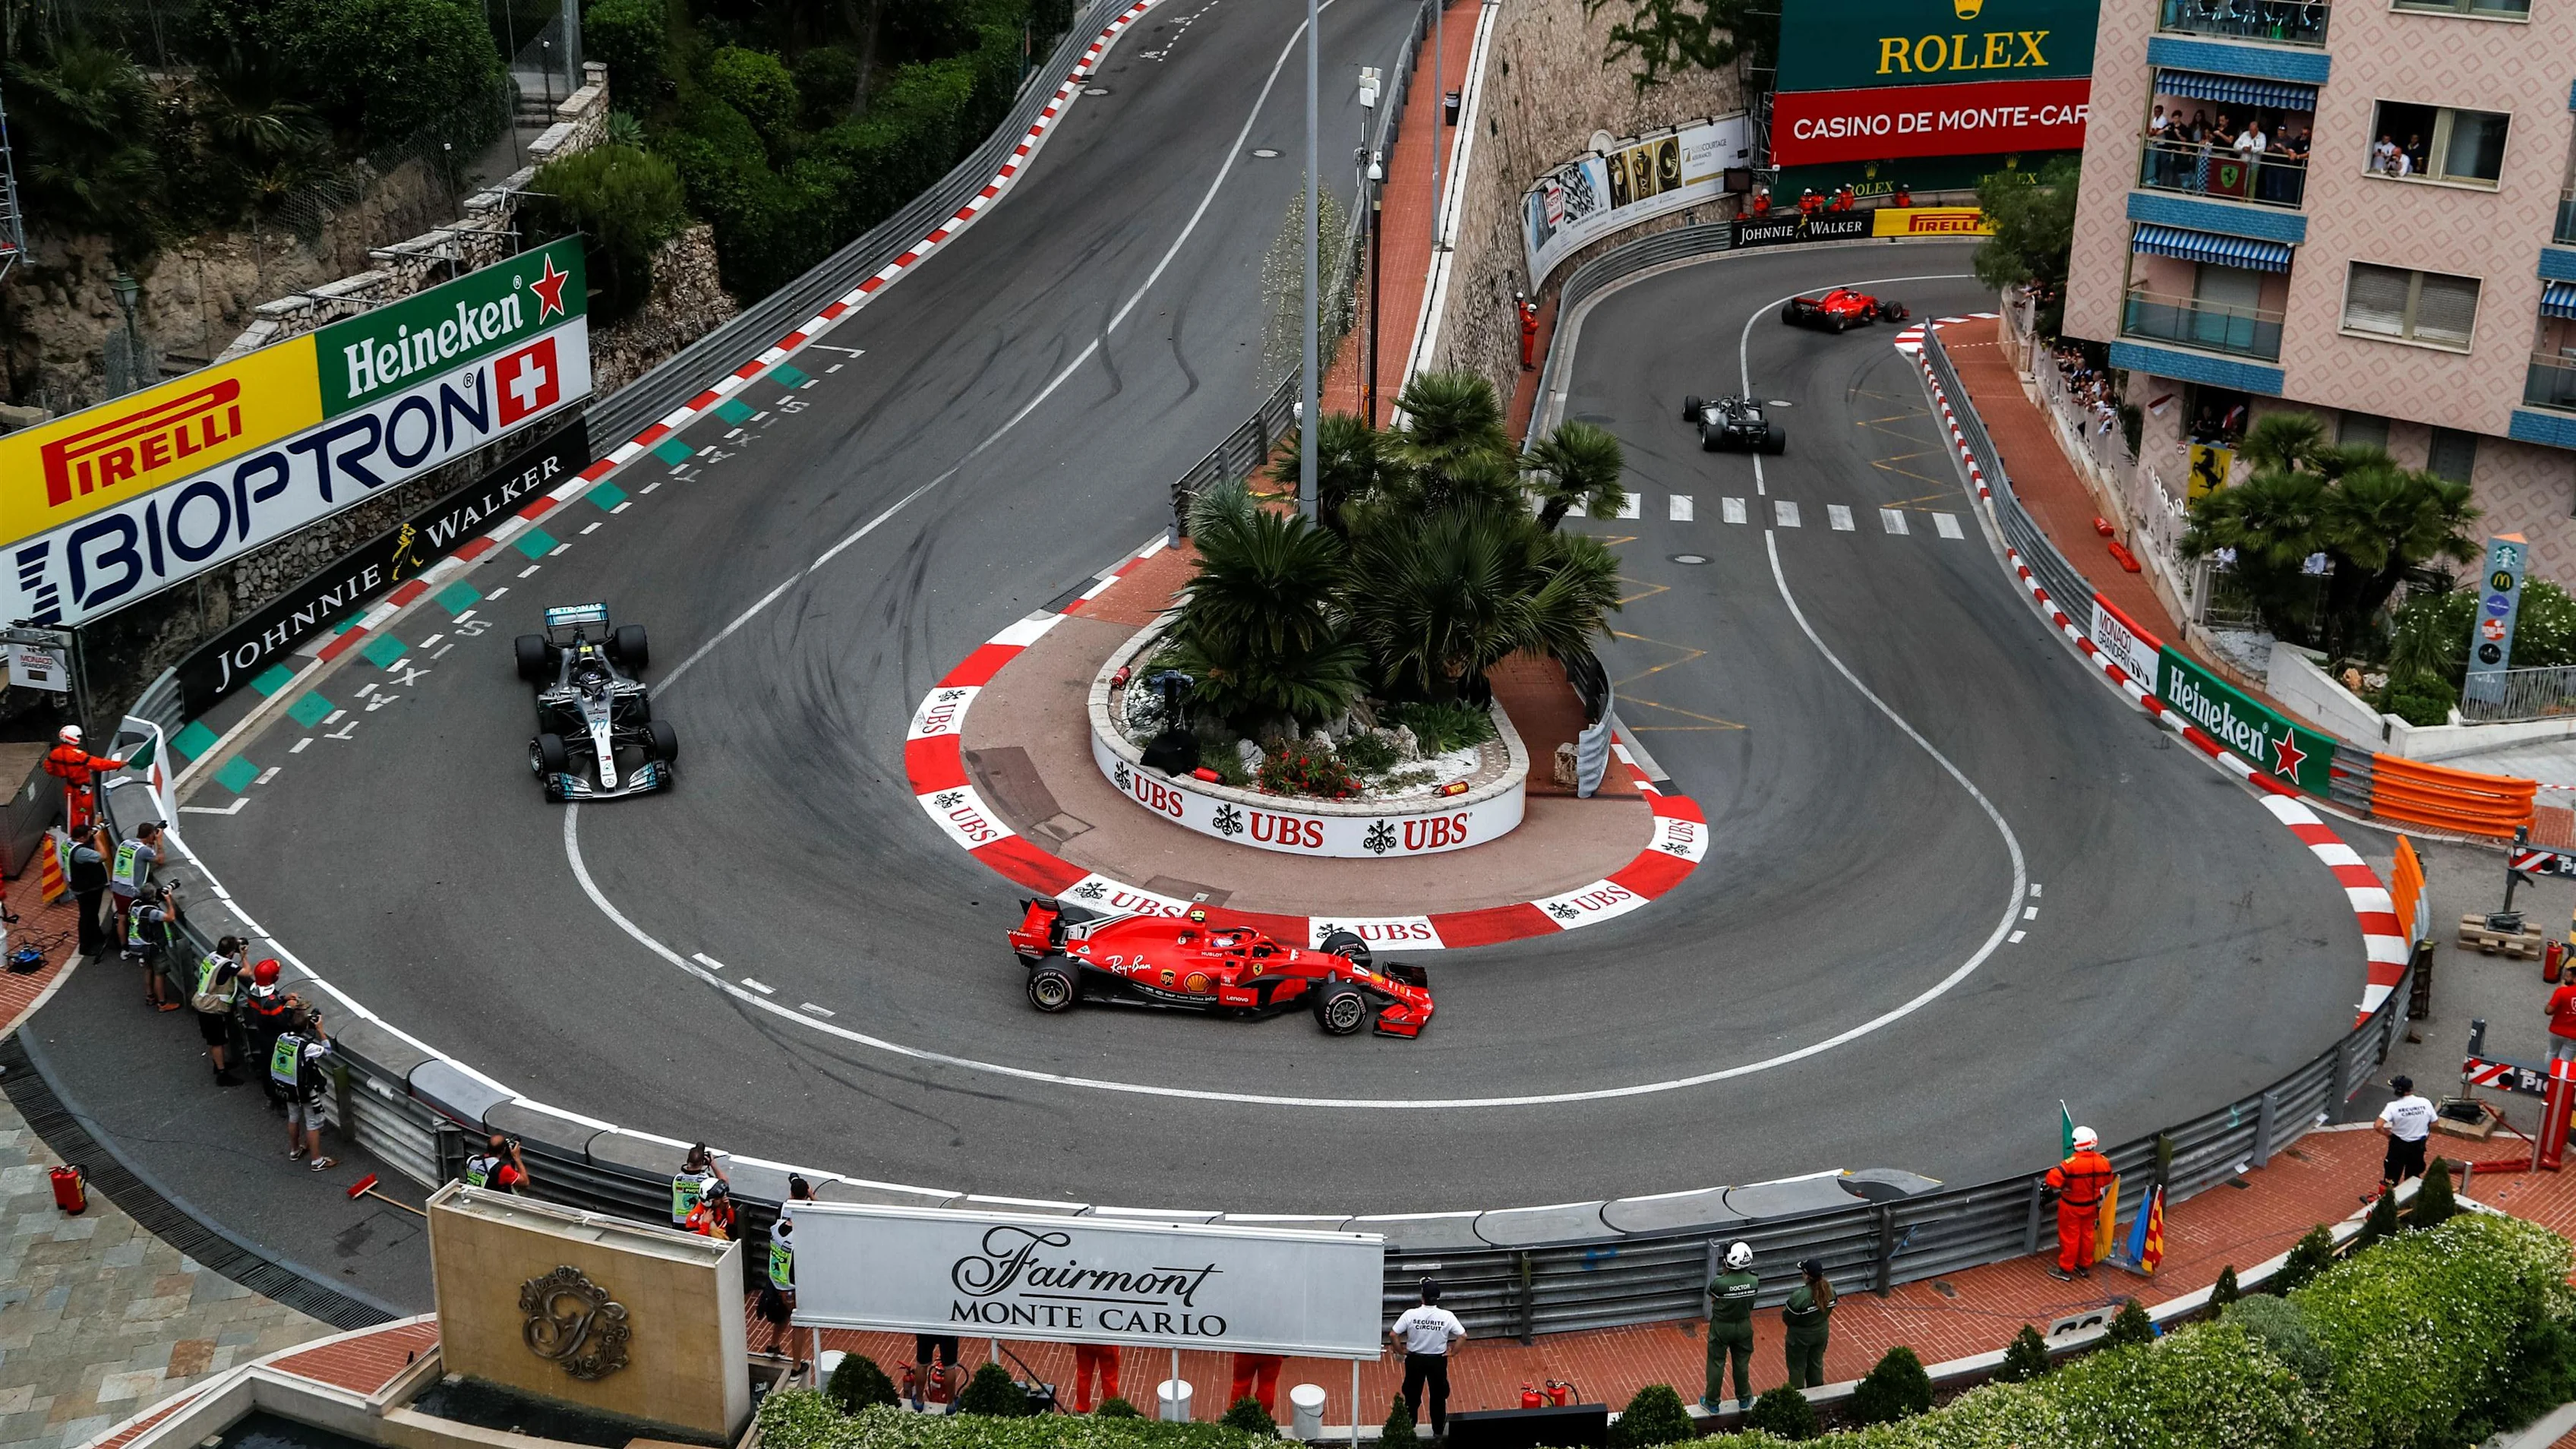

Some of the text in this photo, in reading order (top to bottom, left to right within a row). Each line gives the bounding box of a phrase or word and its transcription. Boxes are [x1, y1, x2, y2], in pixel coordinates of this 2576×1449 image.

[1876, 30, 2050, 74] ROLEX
[1793, 114, 1891, 140] CASINO
[1898, 112, 1933, 134] DE
[1740, 221, 1862, 245] JOHNNIE WALKER
[1908, 213, 1979, 232] PIRELLI
[343, 292, 524, 399] Heineken
[40, 378, 242, 507] PIRELLI
[66, 366, 489, 611] BIOPTRON
[215, 455, 561, 693] JOHNNIE WALKER
[549, 603, 602, 614] PETRONAS
[2099, 610, 2131, 655] MONACO
[20, 655, 53, 665] MONACO
[589, 720, 608, 731] 77
[922, 702, 957, 734] UBS
[2168, 665, 2265, 762] Heineken
[1134, 772, 1184, 818] UBS
[949, 805, 998, 842] UBS
[1249, 811, 1324, 848] UBS
[1403, 813, 1468, 851] UBS
[1668, 819, 1694, 843] UBS
[1571, 886, 1631, 911] UBS
[1079, 926, 1088, 939] 7
[1355, 922, 1432, 941] UBS
[1105, 955, 1151, 976] Ray-Ban
[1160, 974, 1174, 985] ups
[1226, 995, 1249, 1003] Lenovo
[952, 1226, 1223, 1307] Fairmont
[1728, 1283, 1750, 1292] DOCTOR
[949, 1299, 1226, 1337] MONTE CARLO
